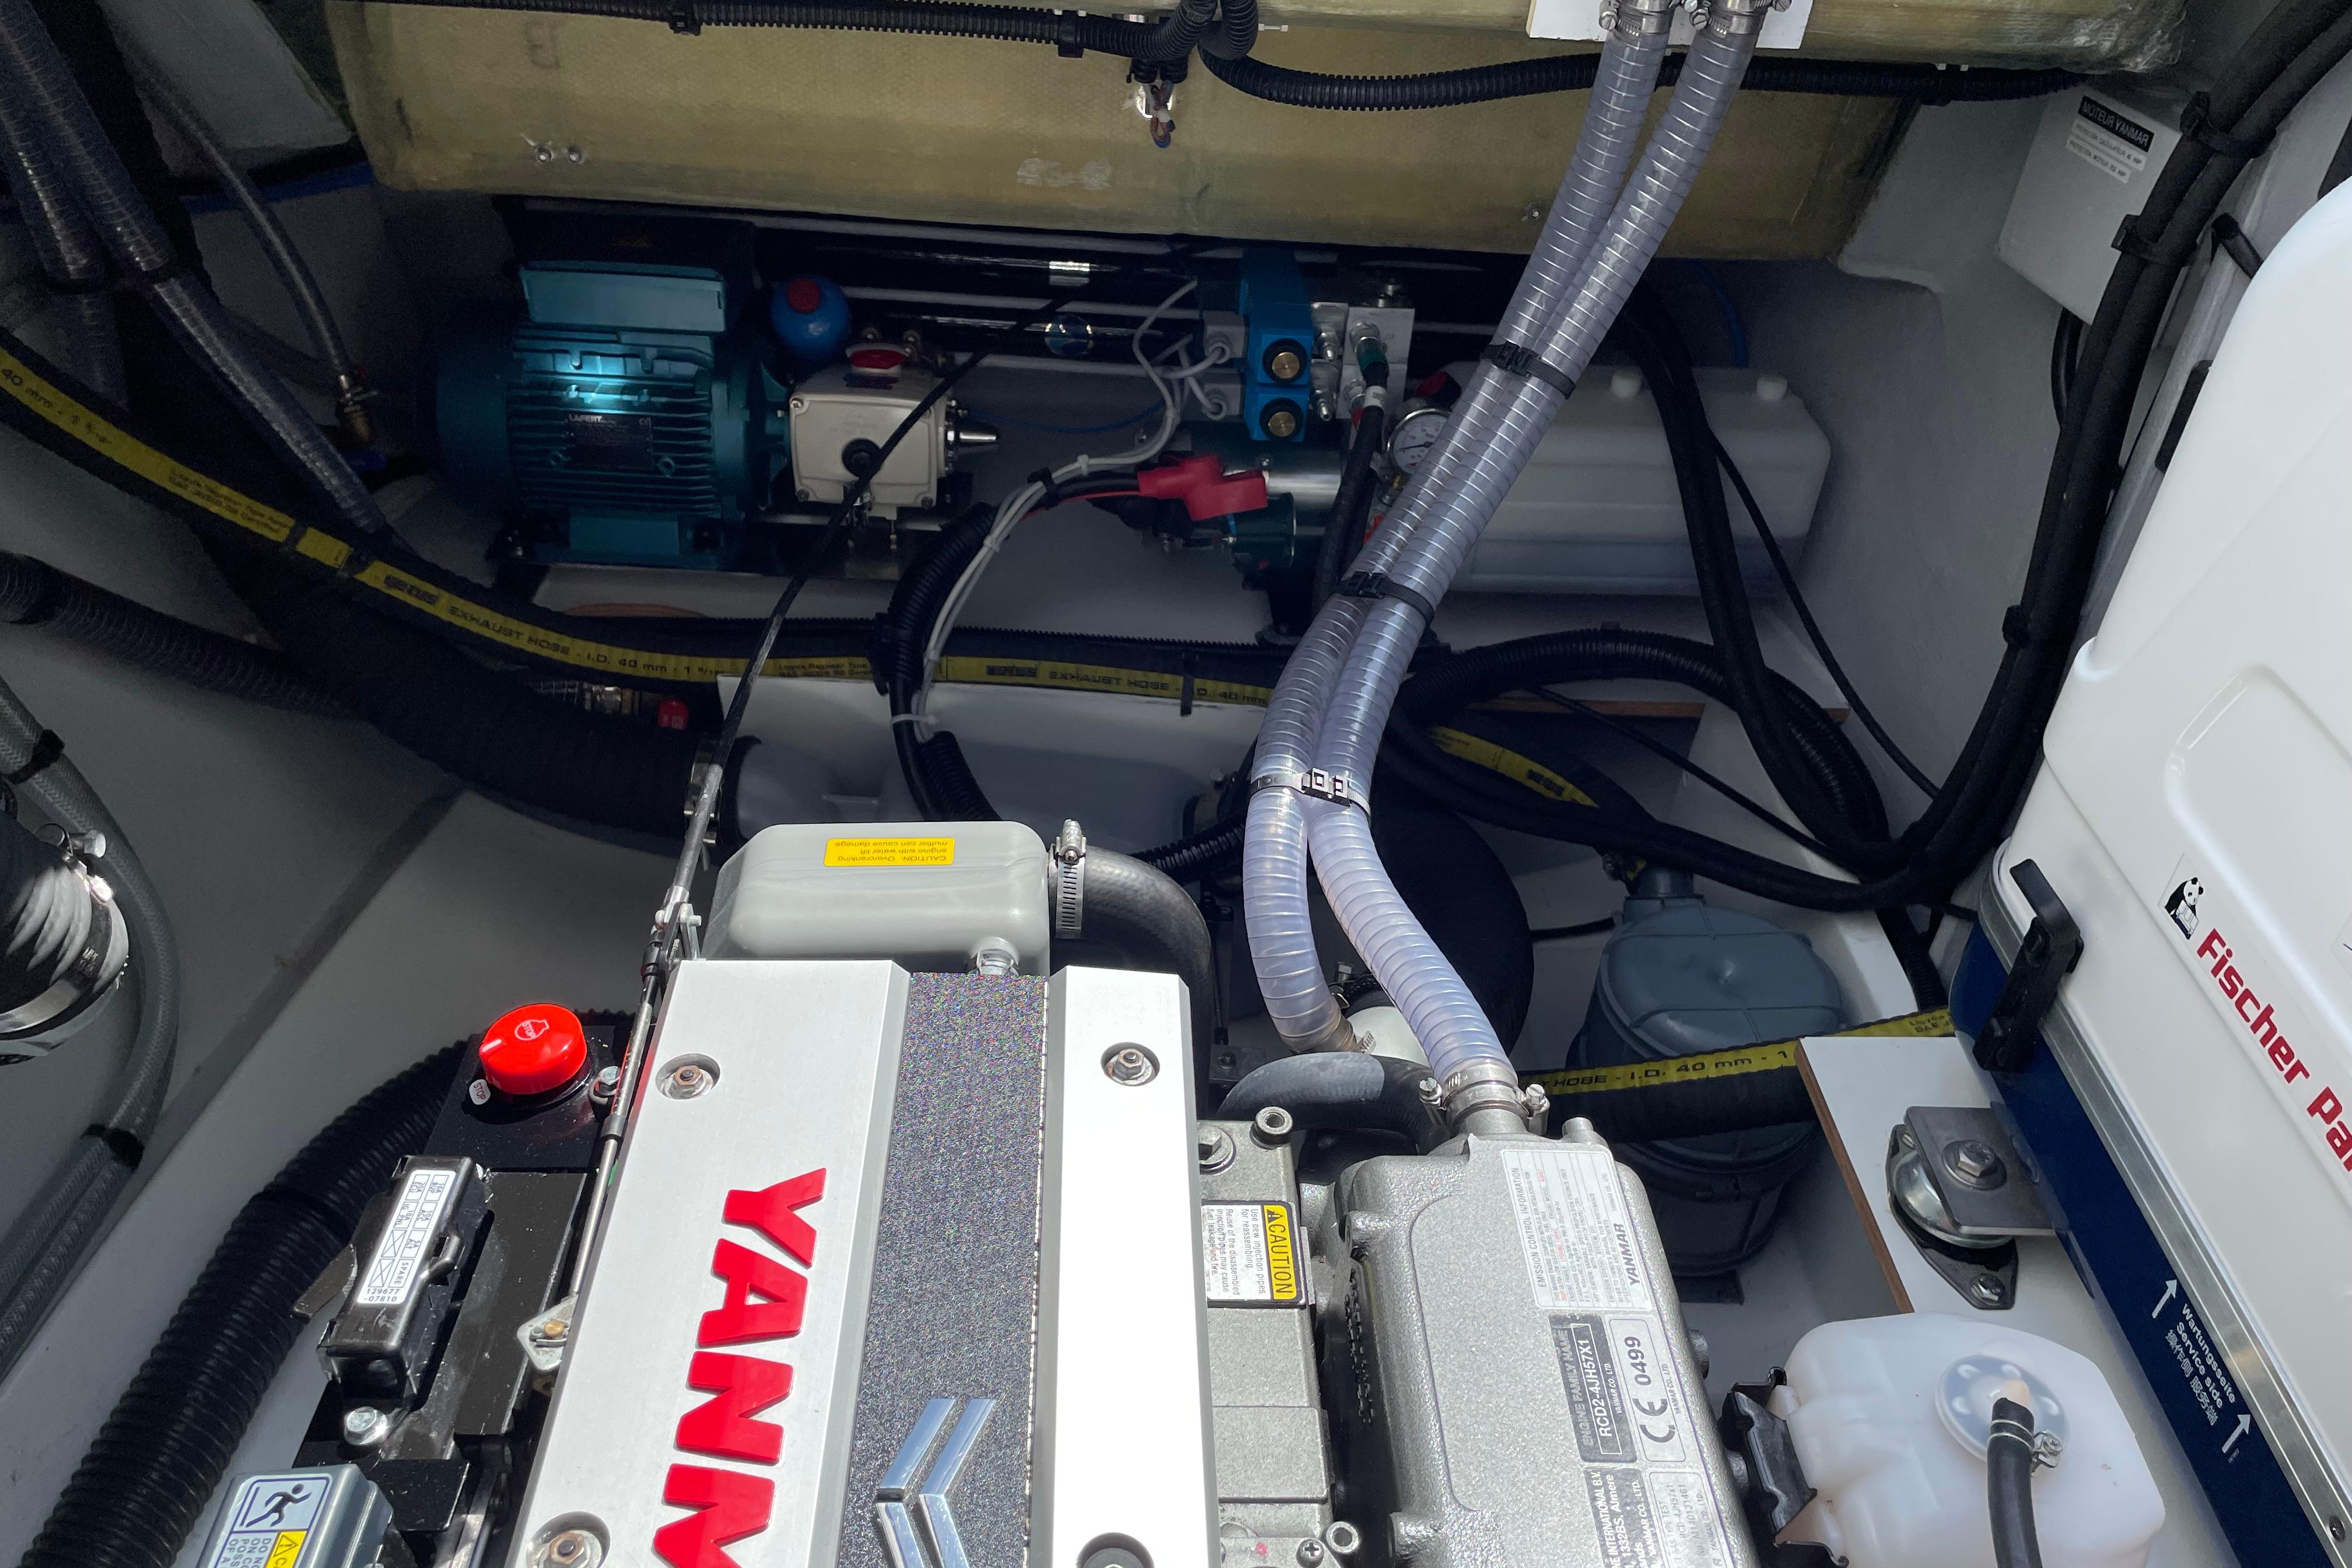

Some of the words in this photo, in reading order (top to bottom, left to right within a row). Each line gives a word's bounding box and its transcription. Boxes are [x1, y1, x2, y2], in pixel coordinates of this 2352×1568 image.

[2115, 118, 2149, 146] YANMAR
[449, 606, 524, 639] EXHAUST
[527, 636, 570, 655] HOSE
[618, 659, 638, 668] 40
[643, 663, 667, 672] mm
[1049, 671, 1122, 687] EXHAUST
[1126, 679, 1170, 691] HOSE
[522, 1021, 537, 1038] STOP
[2197, 928, 2310, 1084] Fischer
[2306, 1086, 2352, 1172] Pa
[1553, 1074, 1607, 1087] HOSE
[1630, 1069, 1667, 1080] I.D.
[1676, 1062, 1706, 1072] 40
[1714, 1057, 1752, 1069] mm
[473, 1082, 486, 1101] STOP
[1560, 1168, 1568, 1180] USED
[408, 1181, 420, 1192] ECU
[415, 1182, 425, 1192] 20A
[428, 1182, 439, 1193] BUP
[435, 1183, 444, 1193] 10A
[1510, 1167, 1529, 1213] INFORMATION
[1526, 1180, 1538, 1206] REGULATIONS
[1563, 1181, 1573, 1200] ENGINES
[1545, 1202, 1555, 1219] ENGINE
[1588, 1193, 1602, 1224] MAINTENANCE
[1606, 1193, 1617, 1211] YANMAR
[393, 1214, 405, 1227] PNL
[404, 1210, 414, 1220] 10A
[415, 1209, 426, 1221] ACC
[422, 1210, 433, 1221] 10A
[1215, 1208, 1225, 1235] injection
[1225, 1209, 1234, 1227] Reuse
[1241, 1208, 1250, 1219] for
[1250, 1209, 1259, 1221] Use
[1569, 1200, 1580, 1228] PROPULSION
[1206, 1222, 1216, 1247] leakage
[1228, 1237, 1236, 1248] the
[1522, 1216, 1538, 1249] CONTROL
[1545, 1233, 1553, 1247] DIESEL
[1576, 1230, 1585, 1244] SPEED
[1602, 1219, 1616, 1252] ADJUSTMENTS
[404, 1238, 415, 1249] ALT
[1218, 1236, 1226, 1254] pipes
[1539, 1236, 1550, 1256] COMPLIES
[1601, 1237, 1611, 1255] MANUAL
[1252, 1241, 1264, 1271] injection
[1268, 1224, 1293, 1293] CAUTION
[1549, 1248, 1558, 1264] SULFUR
[1580, 1247, 1591, 1268] VARIABLE
[1589, 1256, 1597, 1268] WITH
[1613, 1223, 1640, 1285] YANMAR
[393, 1262, 409, 1284] SPARE
[1228, 1250, 1240, 1295] disassembled
[1530, 1252, 1546, 1287] EMISSION
[1545, 1257, 1554, 1272] ENGINE
[1597, 1256, 1608, 1278] CONTROL
[1606, 1256, 1617, 1278] OWNER'S
[1256, 1273, 1266, 1293] pipes
[1549, 1274, 1558, 1290] MARINE
[1556, 1276, 1564, 1289] ULTRA
[1572, 1273, 1584, 1301] STANDARDS
[1604, 1279, 1615, 1302] EMISSION
[1615, 1265, 1630, 1303] SPECIFICATIONS
[1566, 1284, 1576, 1301] ENGINE
[1615, 1287, 1624, 1303] REFER
[1557, 1330, 1573, 1360] NAME
[2182, 1303, 2235, 1404] Wartungsseite
[1623, 1335, 1652, 1386] 0499
[2176, 1321, 2206, 1375] Service
[2204, 1376, 2222, 1408] side
[1564, 1363, 1583, 1401] FAMILY
[1576, 1339, 1612, 1436] RCD2-4JH57X1
[1610, 1390, 1622, 1413] YANMAR
[1668, 1389, 1681, 1414] YANMAR
[1574, 1404, 1594, 1446] ENGINE
[1590, 1471, 1602, 1485] B.V.
[1630, 1479, 1643, 1496] LTD.
[1604, 1474, 1621, 1512] Almere
[1658, 1500, 1670, 1517] TEST
[1594, 1487, 1619, 1555] INTERNATIONAL
[1663, 1520, 1675, 1536] TYPE
[228, 1539, 239, 1553] OF
[247, 1538, 260, 1553] ON
[259, 1538, 272, 1553] DO
[1613, 1515, 1632, 1557] 1332BS,
[1640, 1518, 1657, 1556] YANMAR
[1703, 1522, 1719, 1550] YANMAR
